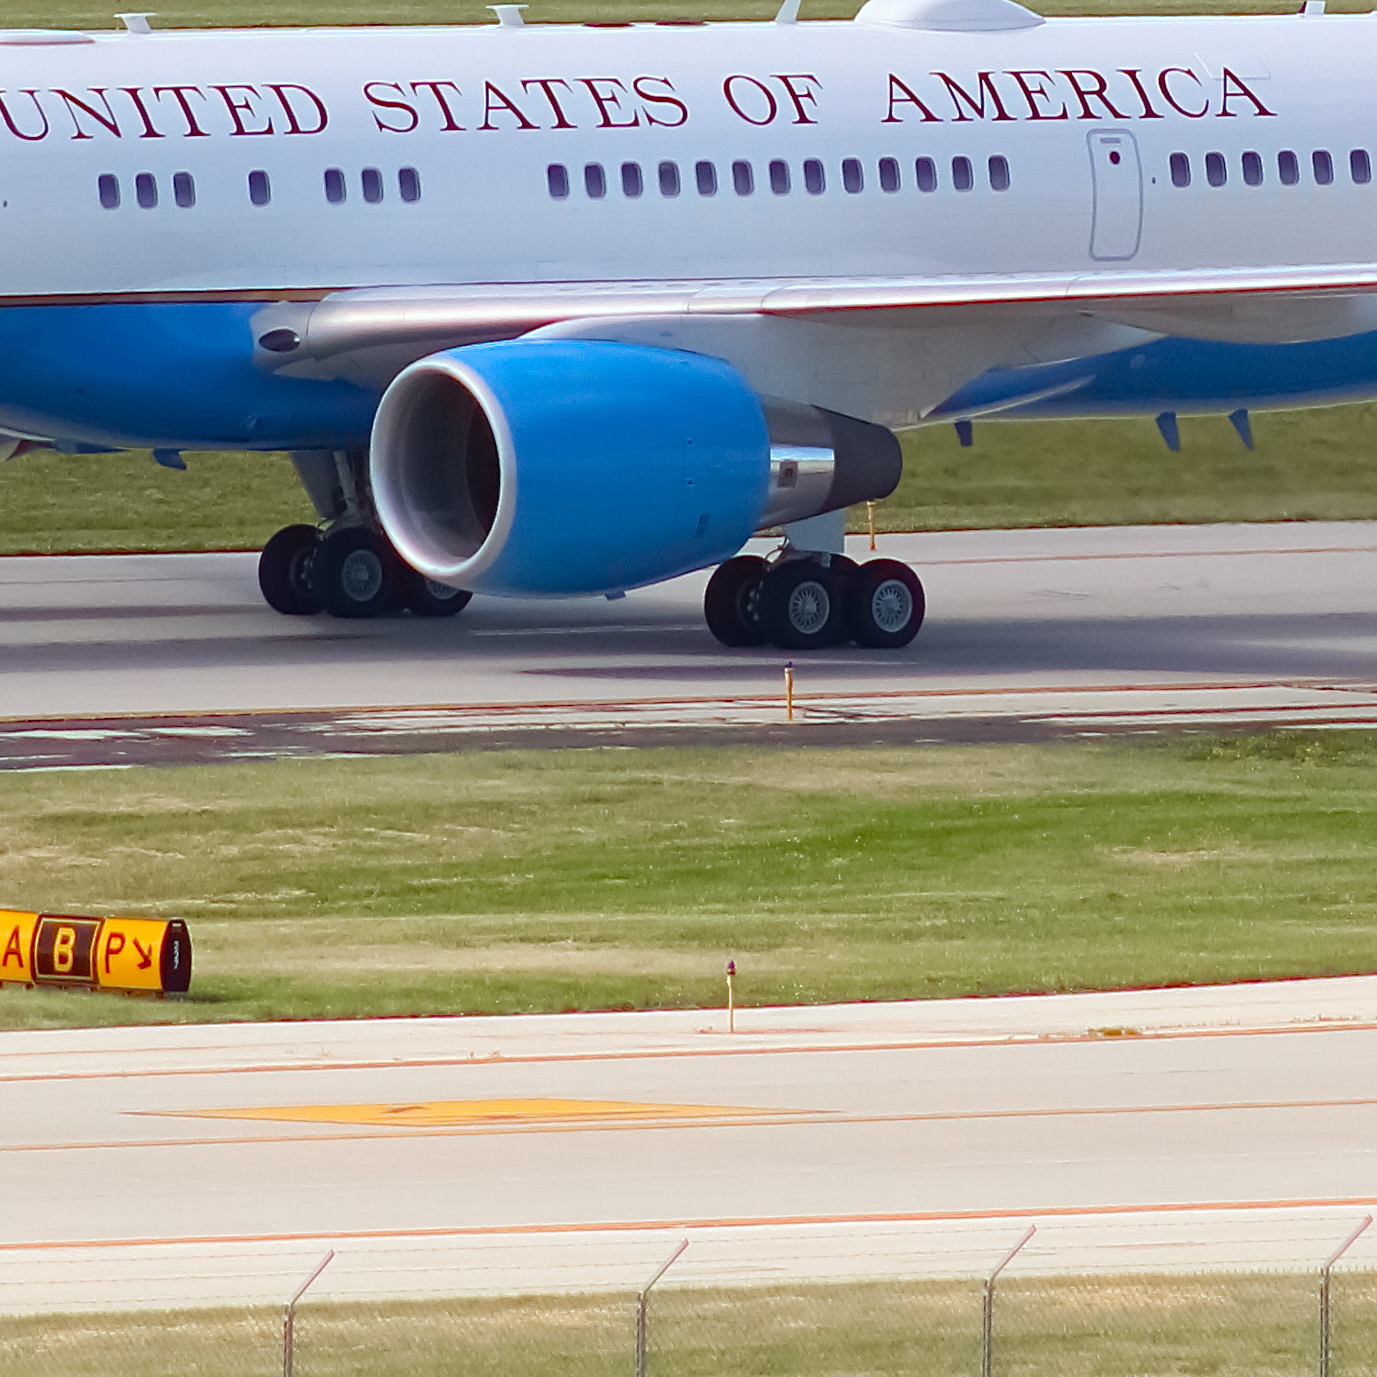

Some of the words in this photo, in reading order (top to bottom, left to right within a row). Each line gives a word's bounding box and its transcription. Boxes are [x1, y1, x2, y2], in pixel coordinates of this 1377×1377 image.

[362, 75, 690, 134] STATES
[722, 73, 824, 126] OF
[880, 65, 1279, 123] AMERICA
[2, 925, 24, 968] A
[53, 926, 77, 972] B
[104, 932, 126, 974] P
